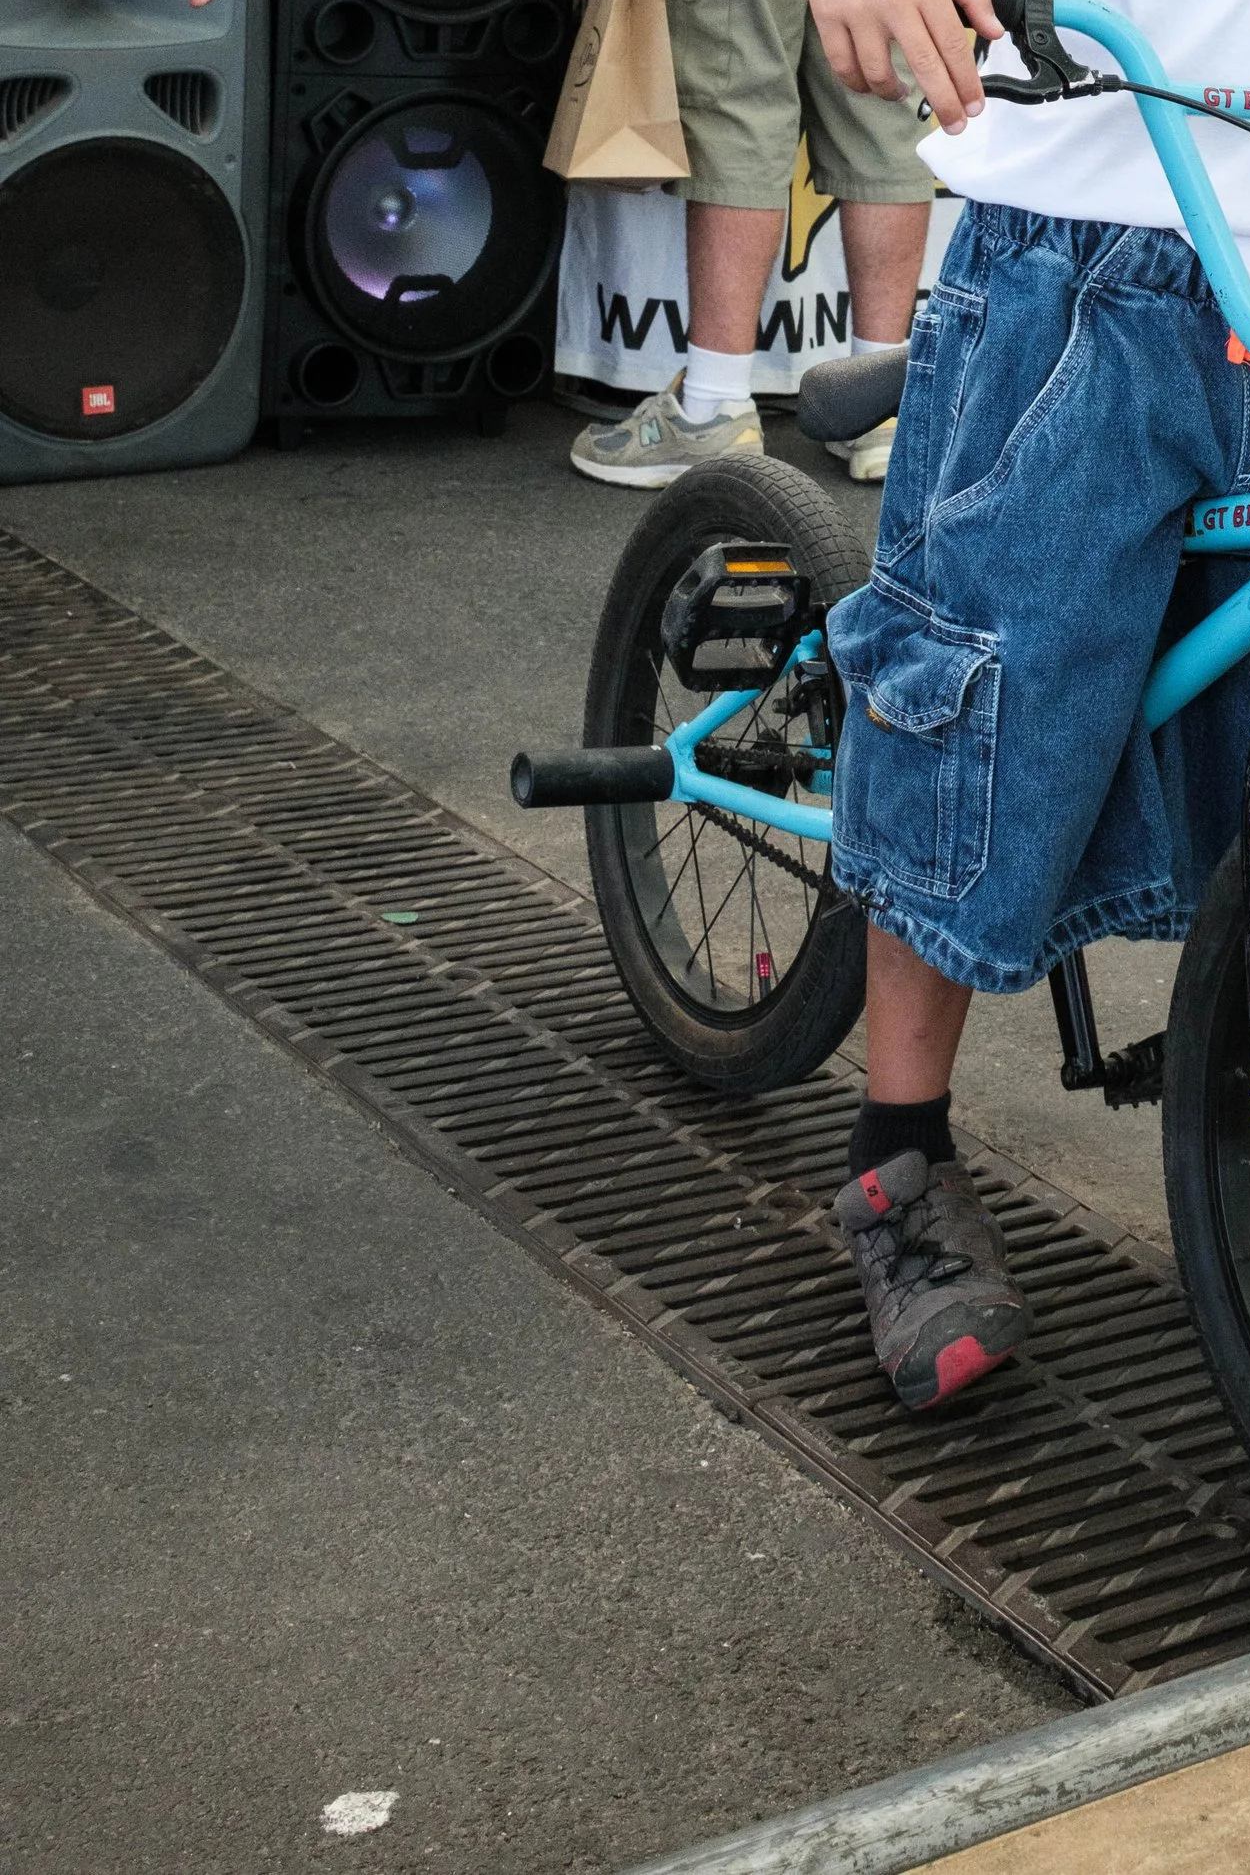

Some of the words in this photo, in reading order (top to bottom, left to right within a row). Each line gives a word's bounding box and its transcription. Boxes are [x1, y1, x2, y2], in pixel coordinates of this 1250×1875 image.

[1203, 87, 1235, 110] GT
[89, 392, 111, 408] JBL
[1203, 507, 1230, 531] GT
